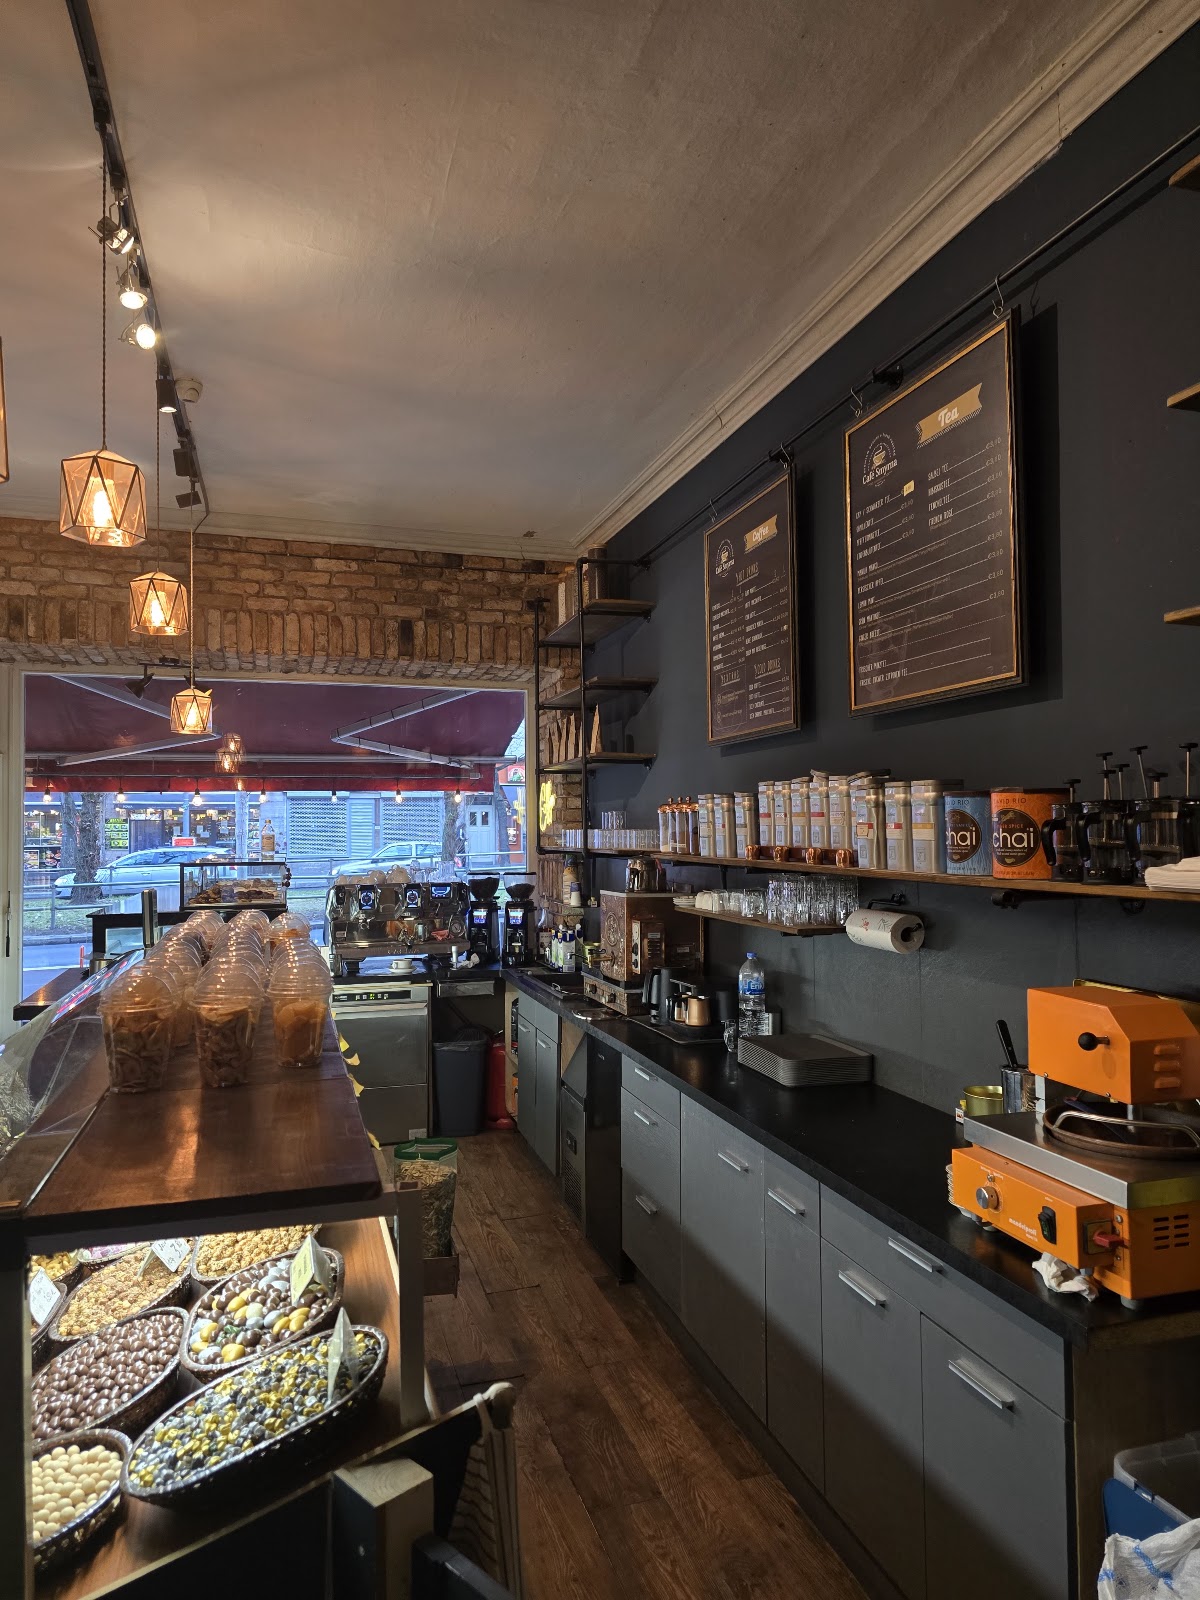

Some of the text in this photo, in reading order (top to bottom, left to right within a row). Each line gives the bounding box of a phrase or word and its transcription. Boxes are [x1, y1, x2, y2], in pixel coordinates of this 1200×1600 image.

[938, 405, 960, 428] Tea
[862, 469, 875, 485] Café
[875, 458, 898, 478] Smyrna
[752, 525, 770, 543] Coffee
[1013, 797, 1027, 805] RIO
